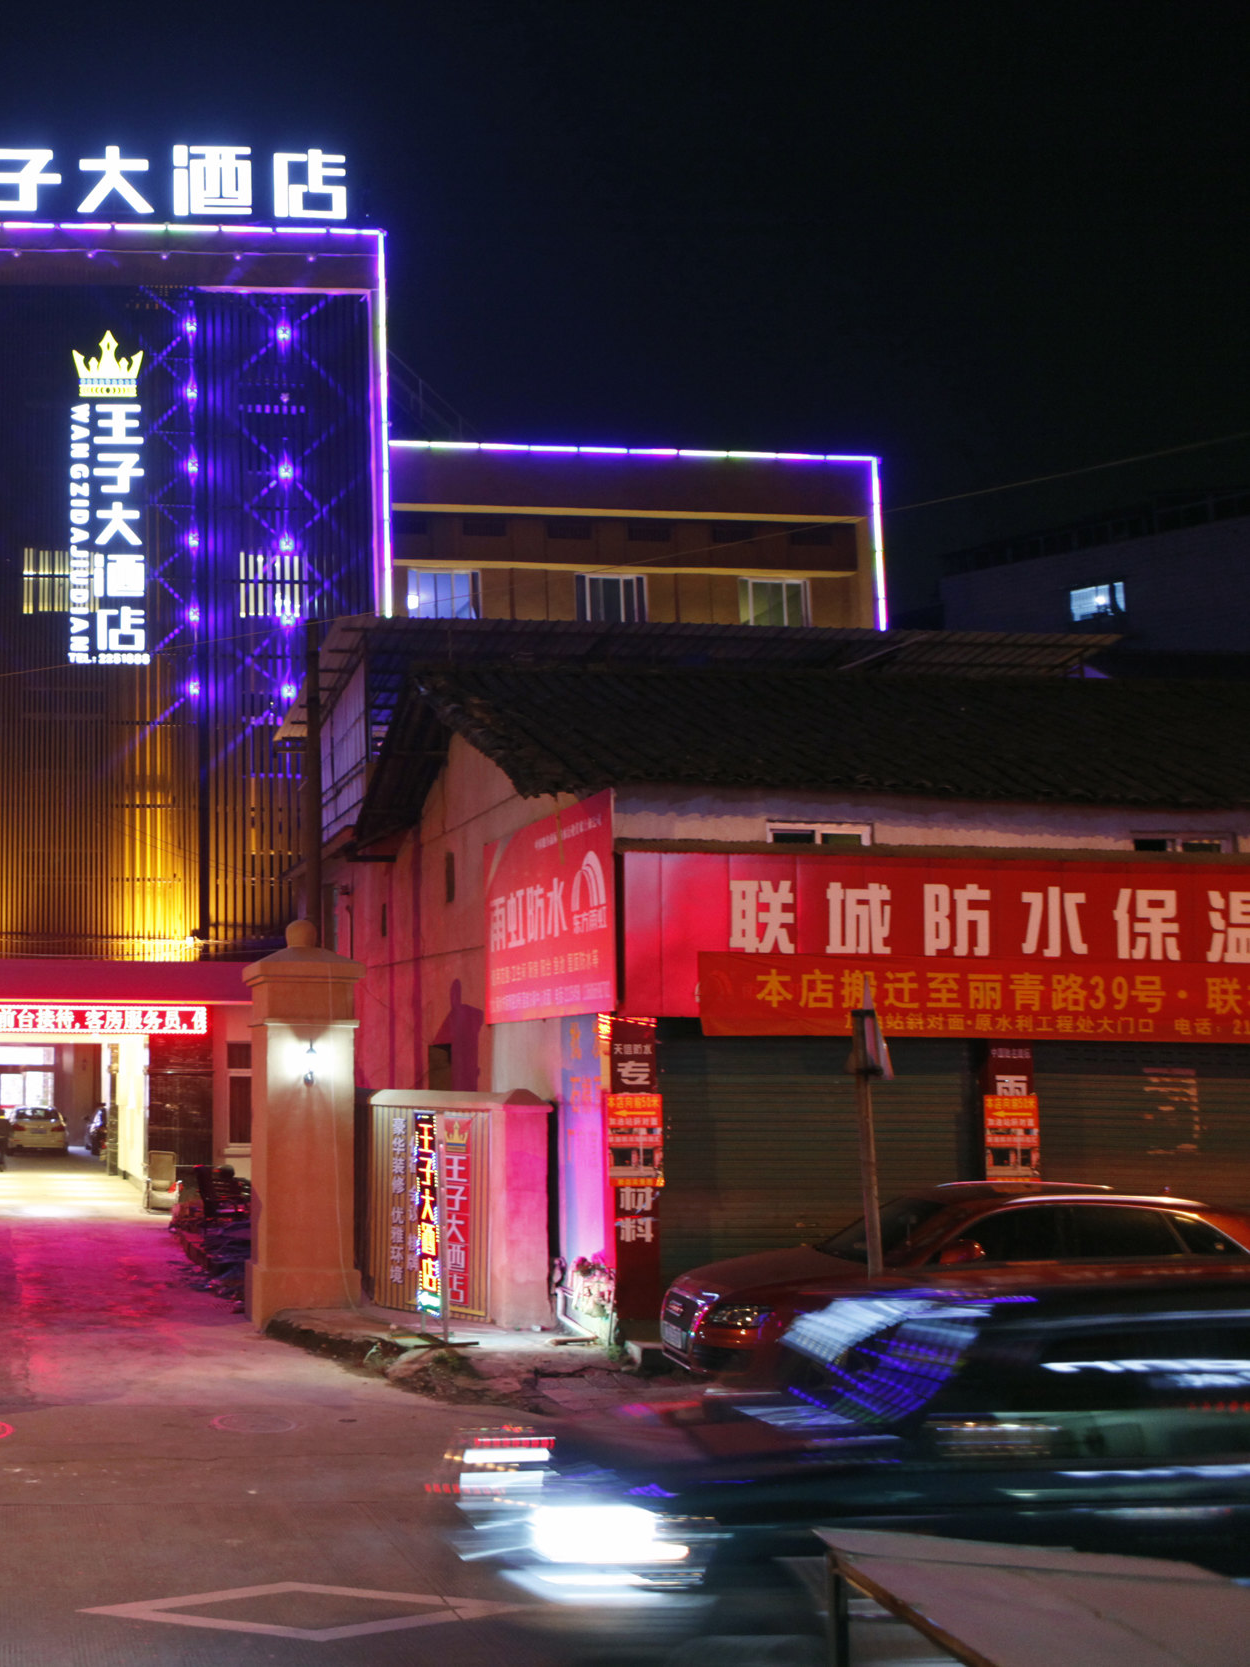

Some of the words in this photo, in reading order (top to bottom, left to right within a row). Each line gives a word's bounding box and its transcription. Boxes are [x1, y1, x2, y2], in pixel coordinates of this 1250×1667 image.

[93, 403, 145, 651] 王子大酒店
[490, 877, 568, 953] 雨虹防水
[728, 879, 1250, 963] 联城防水保温
[756, 969, 1250, 1016] 本店搬迁至丽青路39号·联
[391, 1117, 407, 1195] 豪华装修
[417, 1122, 438, 1293] 王子大酒店
